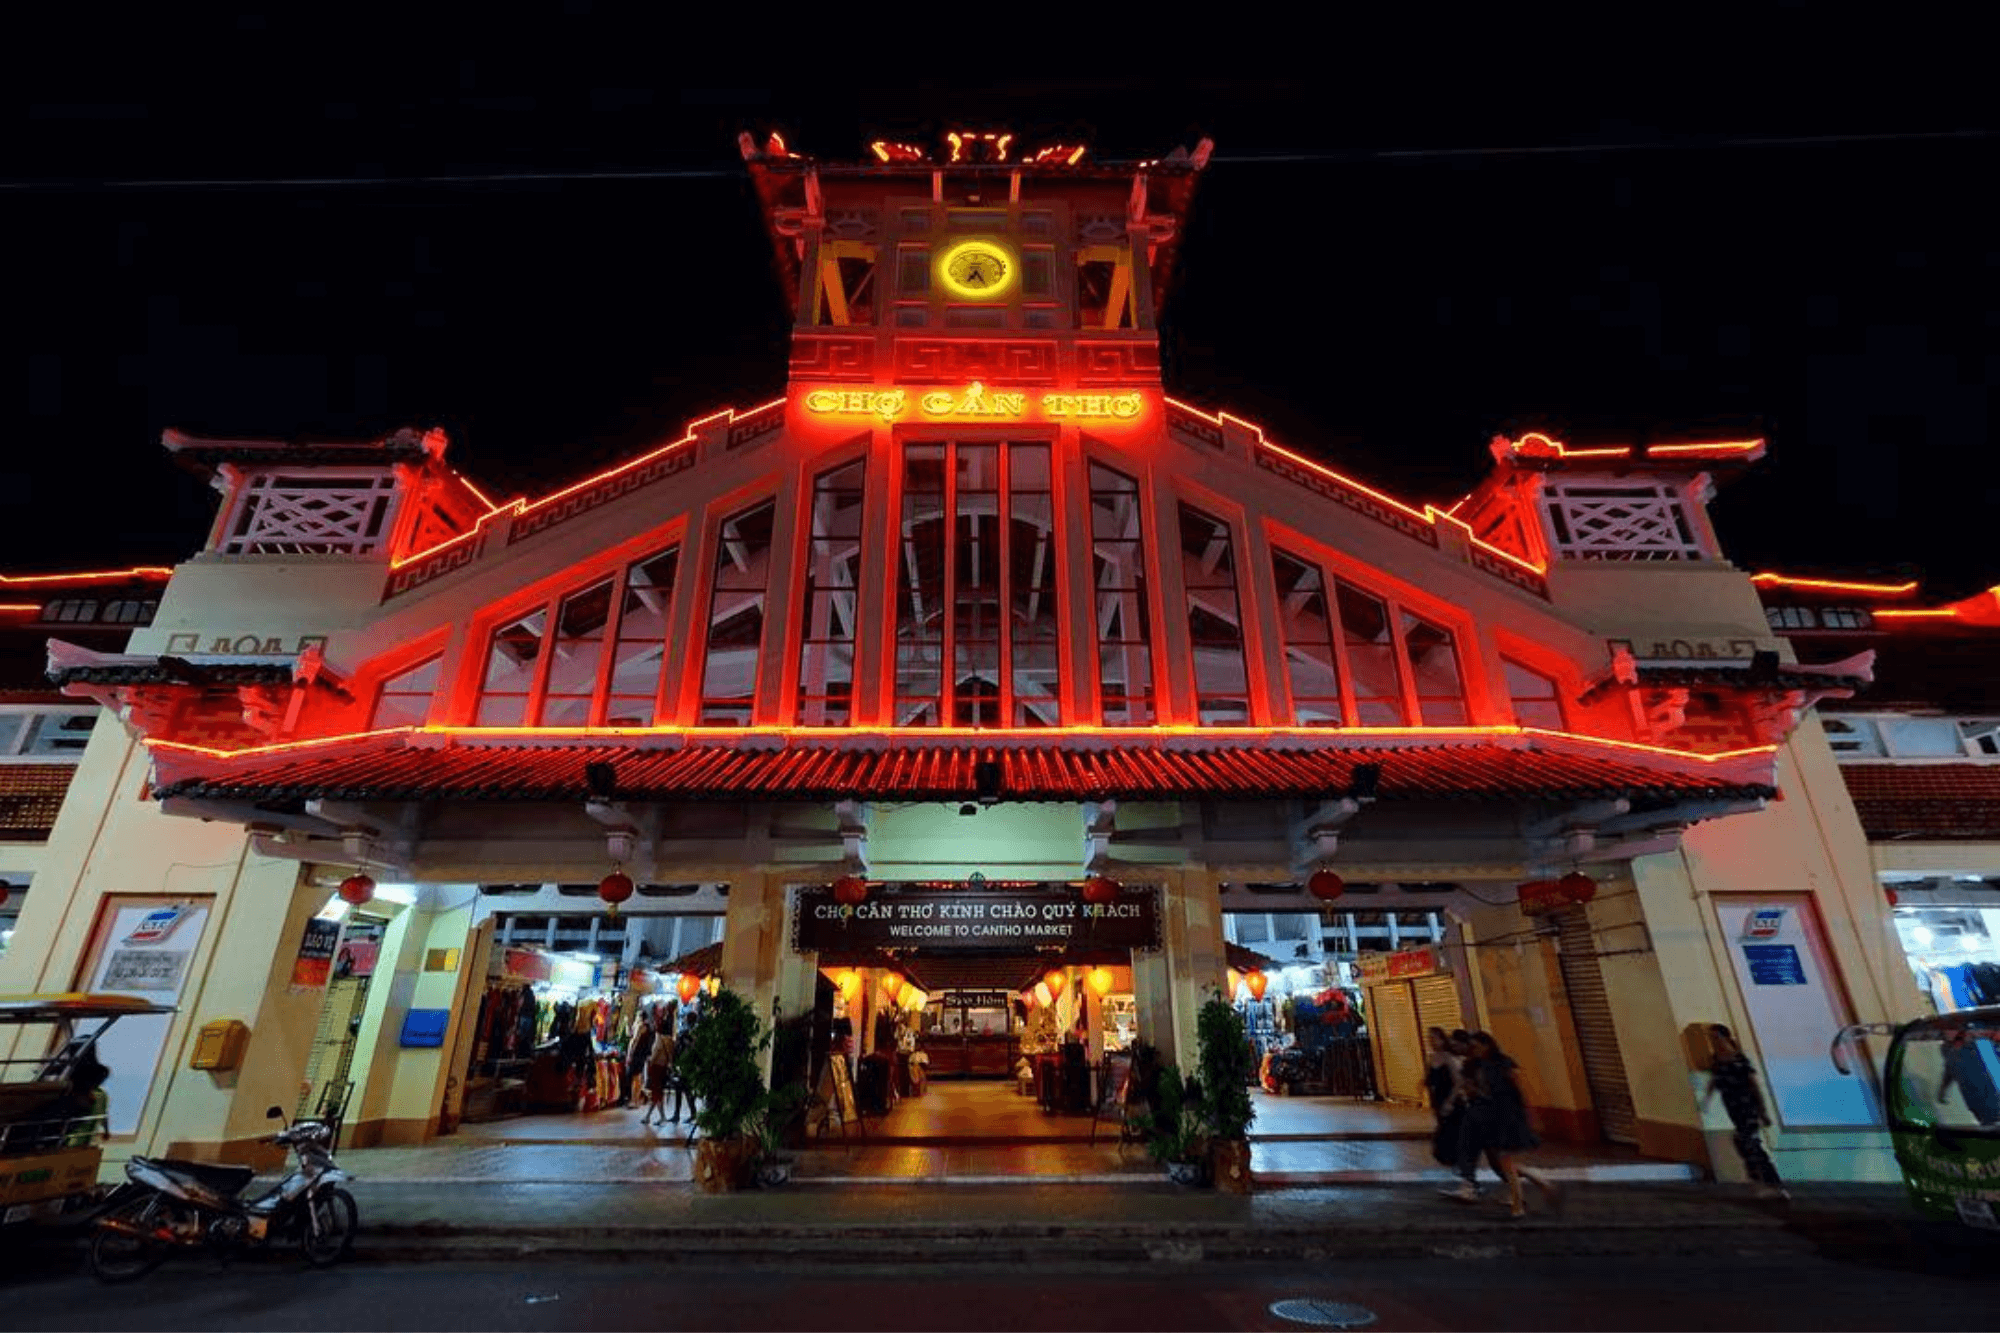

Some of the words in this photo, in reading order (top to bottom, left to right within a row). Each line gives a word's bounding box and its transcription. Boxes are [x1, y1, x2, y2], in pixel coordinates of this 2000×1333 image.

[806, 389, 903, 422] CHỢ
[1043, 391, 1141, 417] THƠ
[897, 903, 933, 919] THƠ
[940, 900, 985, 918] KÍNH
[990, 901, 1036, 918] CHÀO
[1042, 902, 1075, 920] QUÝ
[890, 925, 951, 937] WELCOME
[954, 925, 969, 936] TO
[971, 924, 1020, 936] CANTHO
[1024, 924, 1073, 937] MARKET
